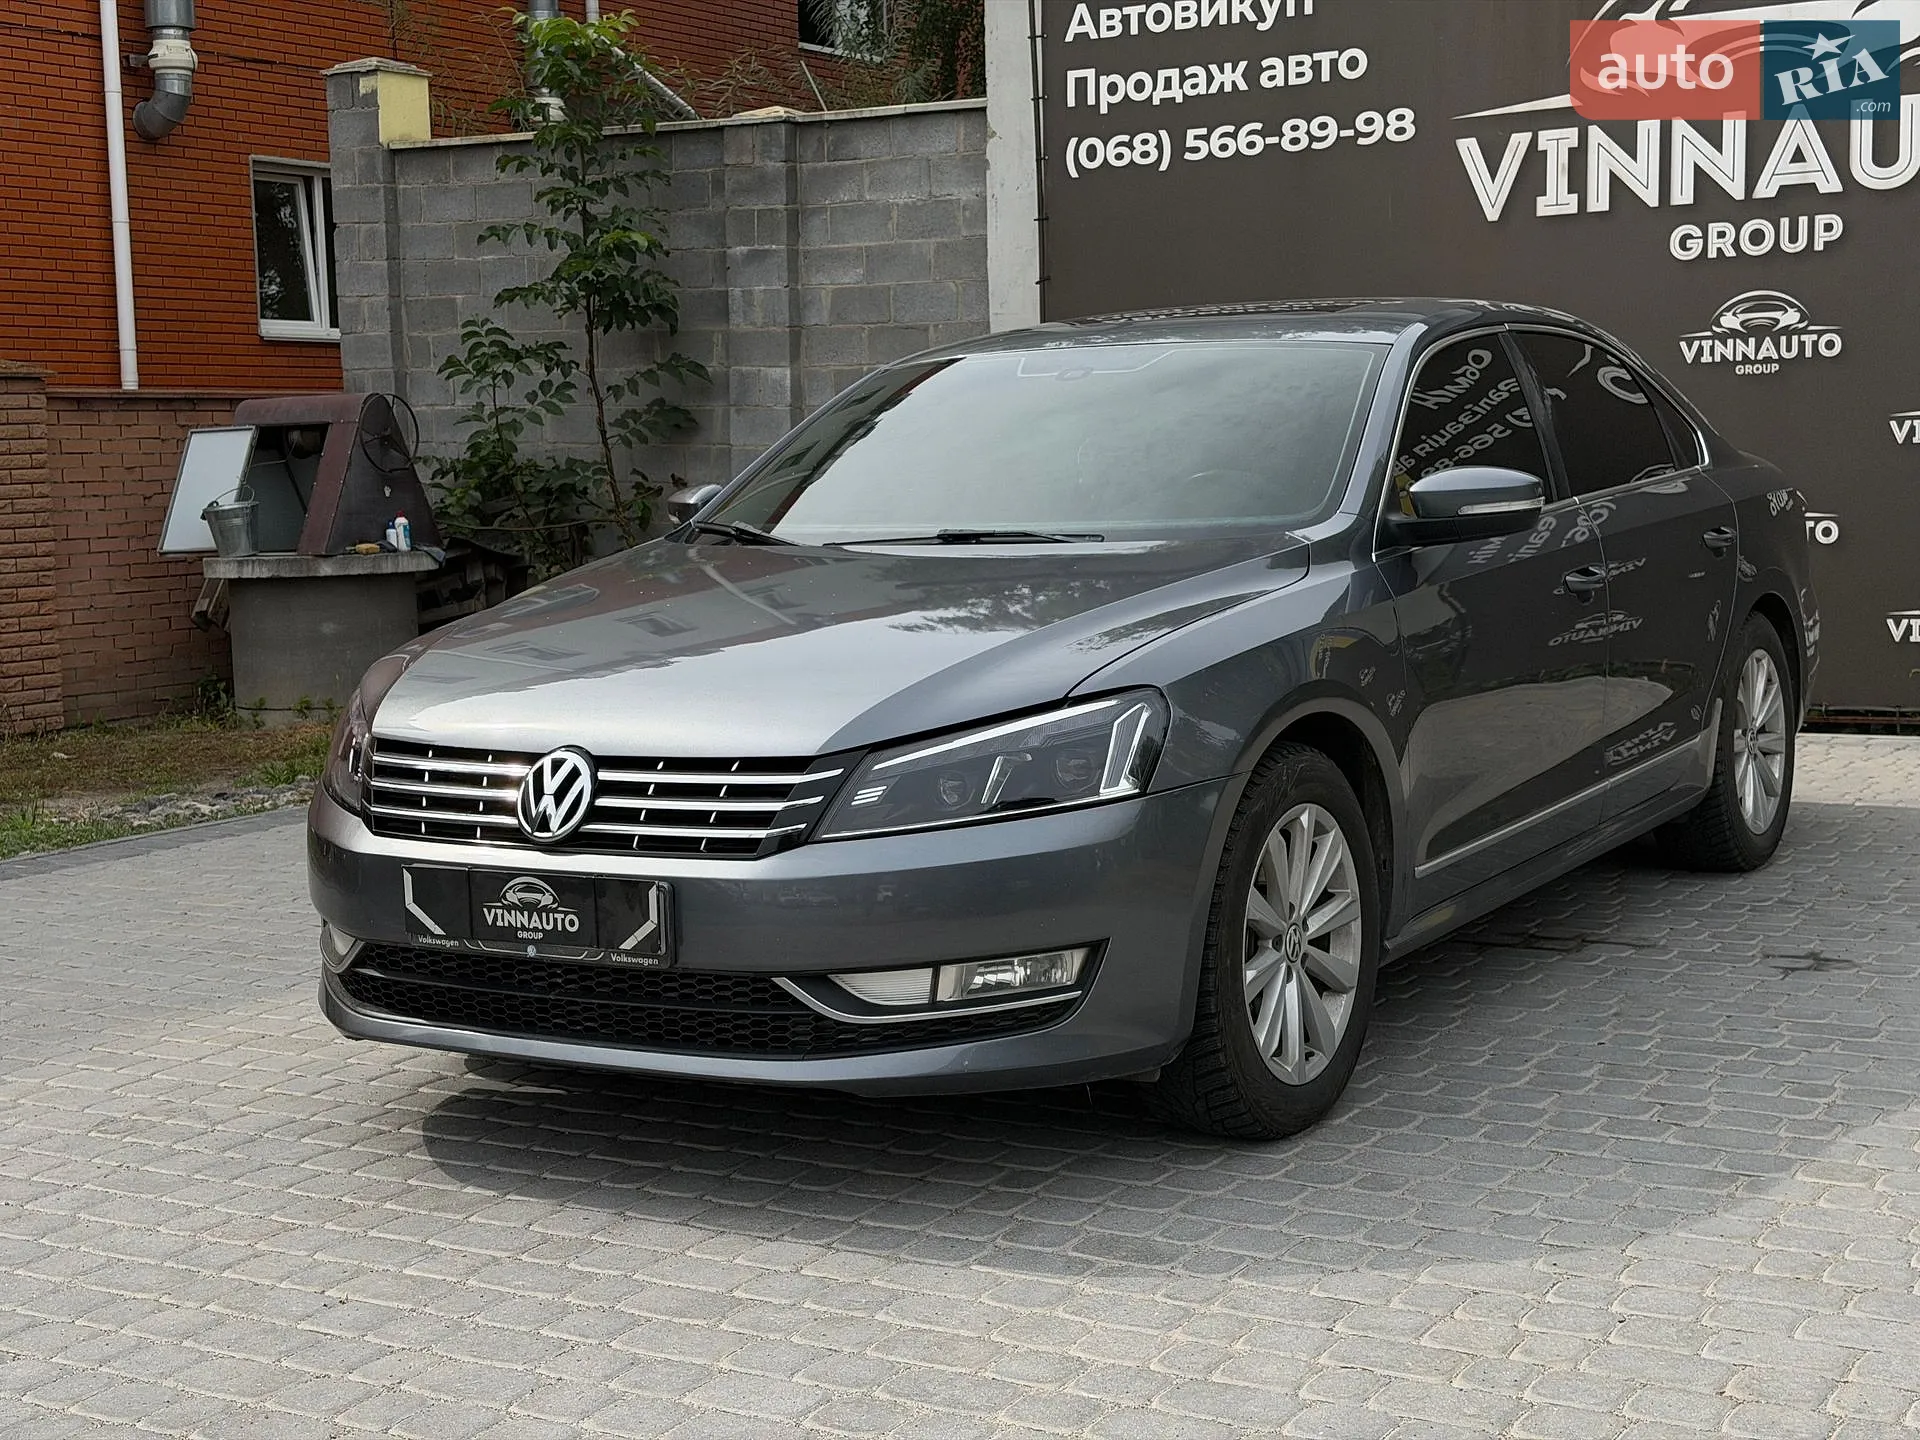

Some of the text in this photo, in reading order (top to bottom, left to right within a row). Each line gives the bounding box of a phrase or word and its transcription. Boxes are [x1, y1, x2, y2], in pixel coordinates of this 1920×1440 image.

[1065, 47, 1369, 115] Продаж авто
[1064, 107, 1416, 179] (068) 566-89-98
[1668, 213, 1844, 262] GROUP
[1678, 332, 1843, 365] VINNAUTO
[1734, 362, 1780, 376] GROUP
[482, 907, 580, 932] VINNAUTO
[417, 934, 459, 947] Volkswagen
[517, 930, 543, 940] GROUP
[610, 952, 659, 965] Volkswagen
